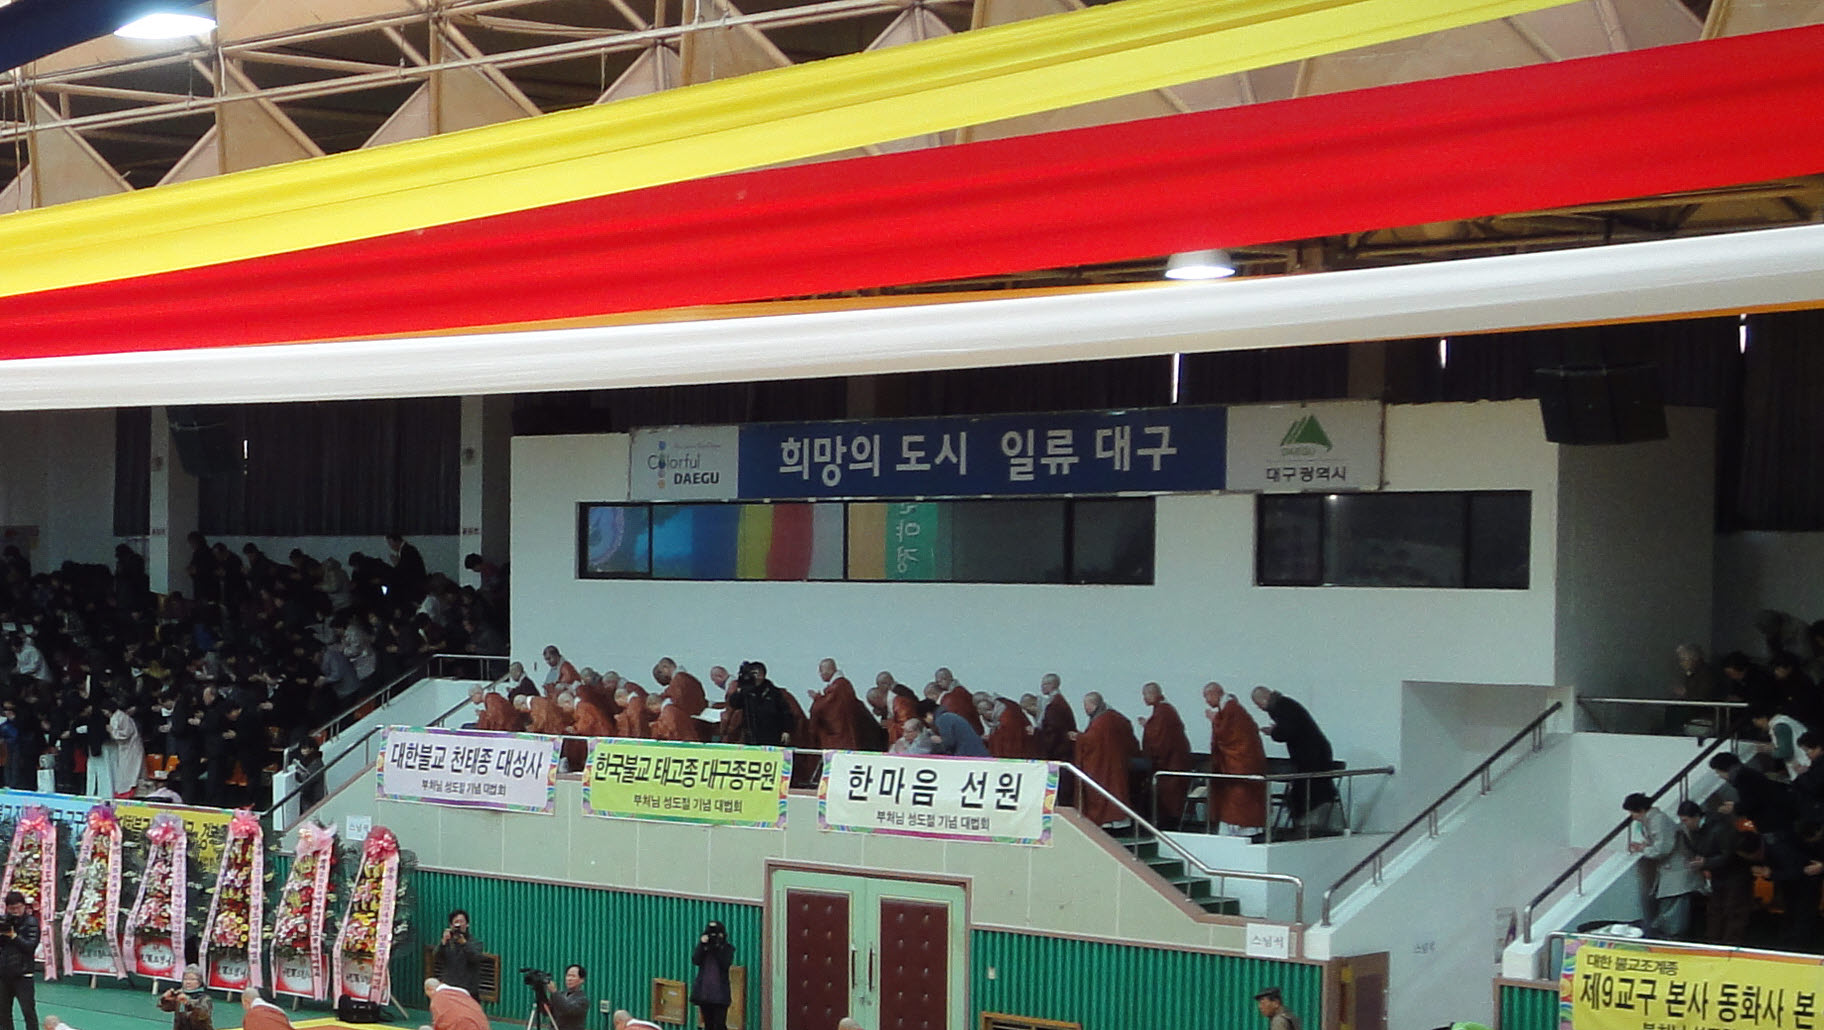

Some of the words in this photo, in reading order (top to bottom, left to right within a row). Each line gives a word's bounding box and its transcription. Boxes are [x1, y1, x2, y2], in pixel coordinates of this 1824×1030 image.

[779, 434, 880, 488] 희망의
[896, 431, 967, 475] 도시
[1001, 429, 1079, 481] 일류
[1095, 425, 1177, 472] 대구
[674, 471, 720, 485] DAEGU
[1266, 466, 1347, 482] 대구광역시
[390, 742, 447, 771] 대한불교
[451, 746, 493, 776] 천태종
[496, 749, 544, 780] 대성사
[594, 752, 652, 784] 한국불교
[654, 756, 699, 788] 태고종
[700, 758, 778, 792] 대구종무원
[847, 764, 939, 807] 한마음
[960, 770, 1023, 811] 선원
[633, 794, 661, 809] 부처님
[663, 796, 691, 811] 성도절
[692, 798, 713, 812] 기념
[714, 799, 743, 814] 대법회
[876, 810, 905, 825] 부처님
[907, 812, 936, 828] 성도절
[938, 814, 958, 829] 기념
[960, 816, 991, 832] 대법회
[1586, 954, 1613, 970] 대한
[1615, 957, 1679, 977] 불교조계종
[1579, 972, 1658, 1017] 제9교구
[1665, 980, 1709, 1021] 본사
[1717, 983, 1785, 1028] 동화사
[1792, 990, 1824, 1030] 본
